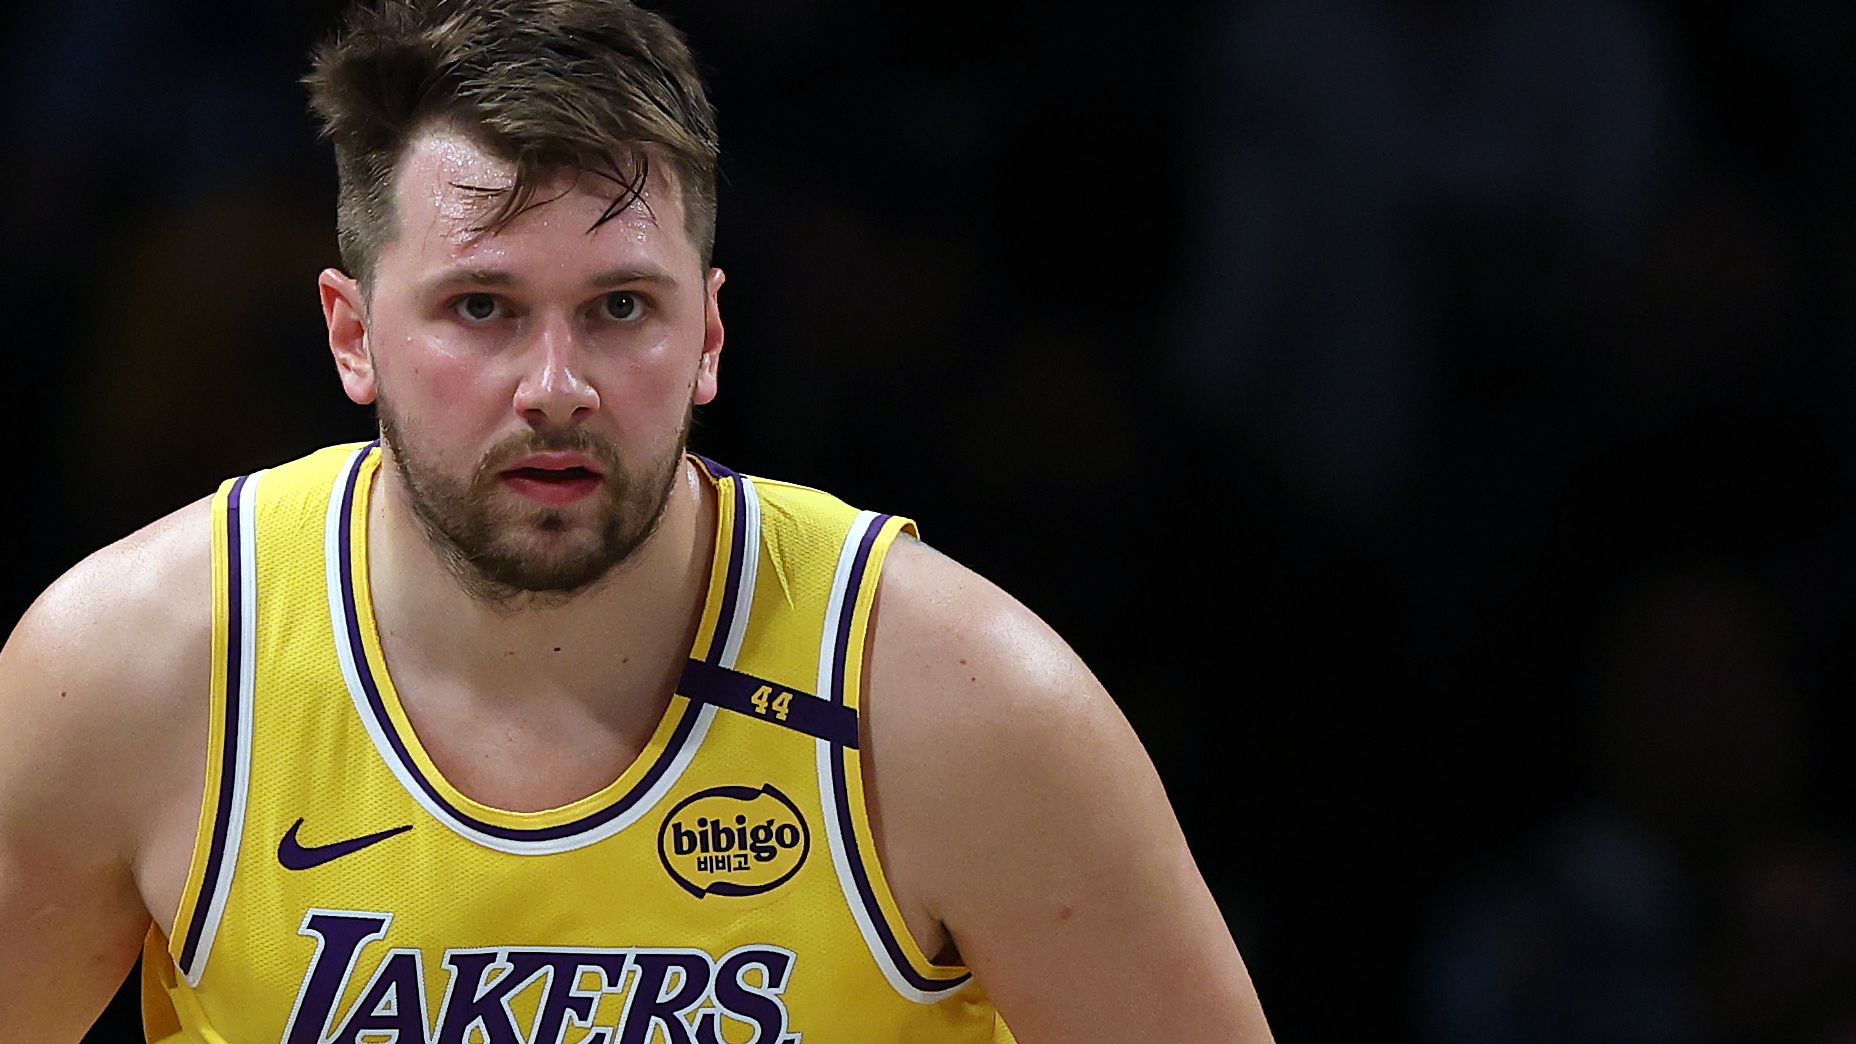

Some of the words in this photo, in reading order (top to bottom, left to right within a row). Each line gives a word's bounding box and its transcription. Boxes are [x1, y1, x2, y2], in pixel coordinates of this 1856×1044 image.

[750, 685, 794, 721] 44
[672, 815, 800, 862] bibigo
[696, 853, 751, 874] 비비고
